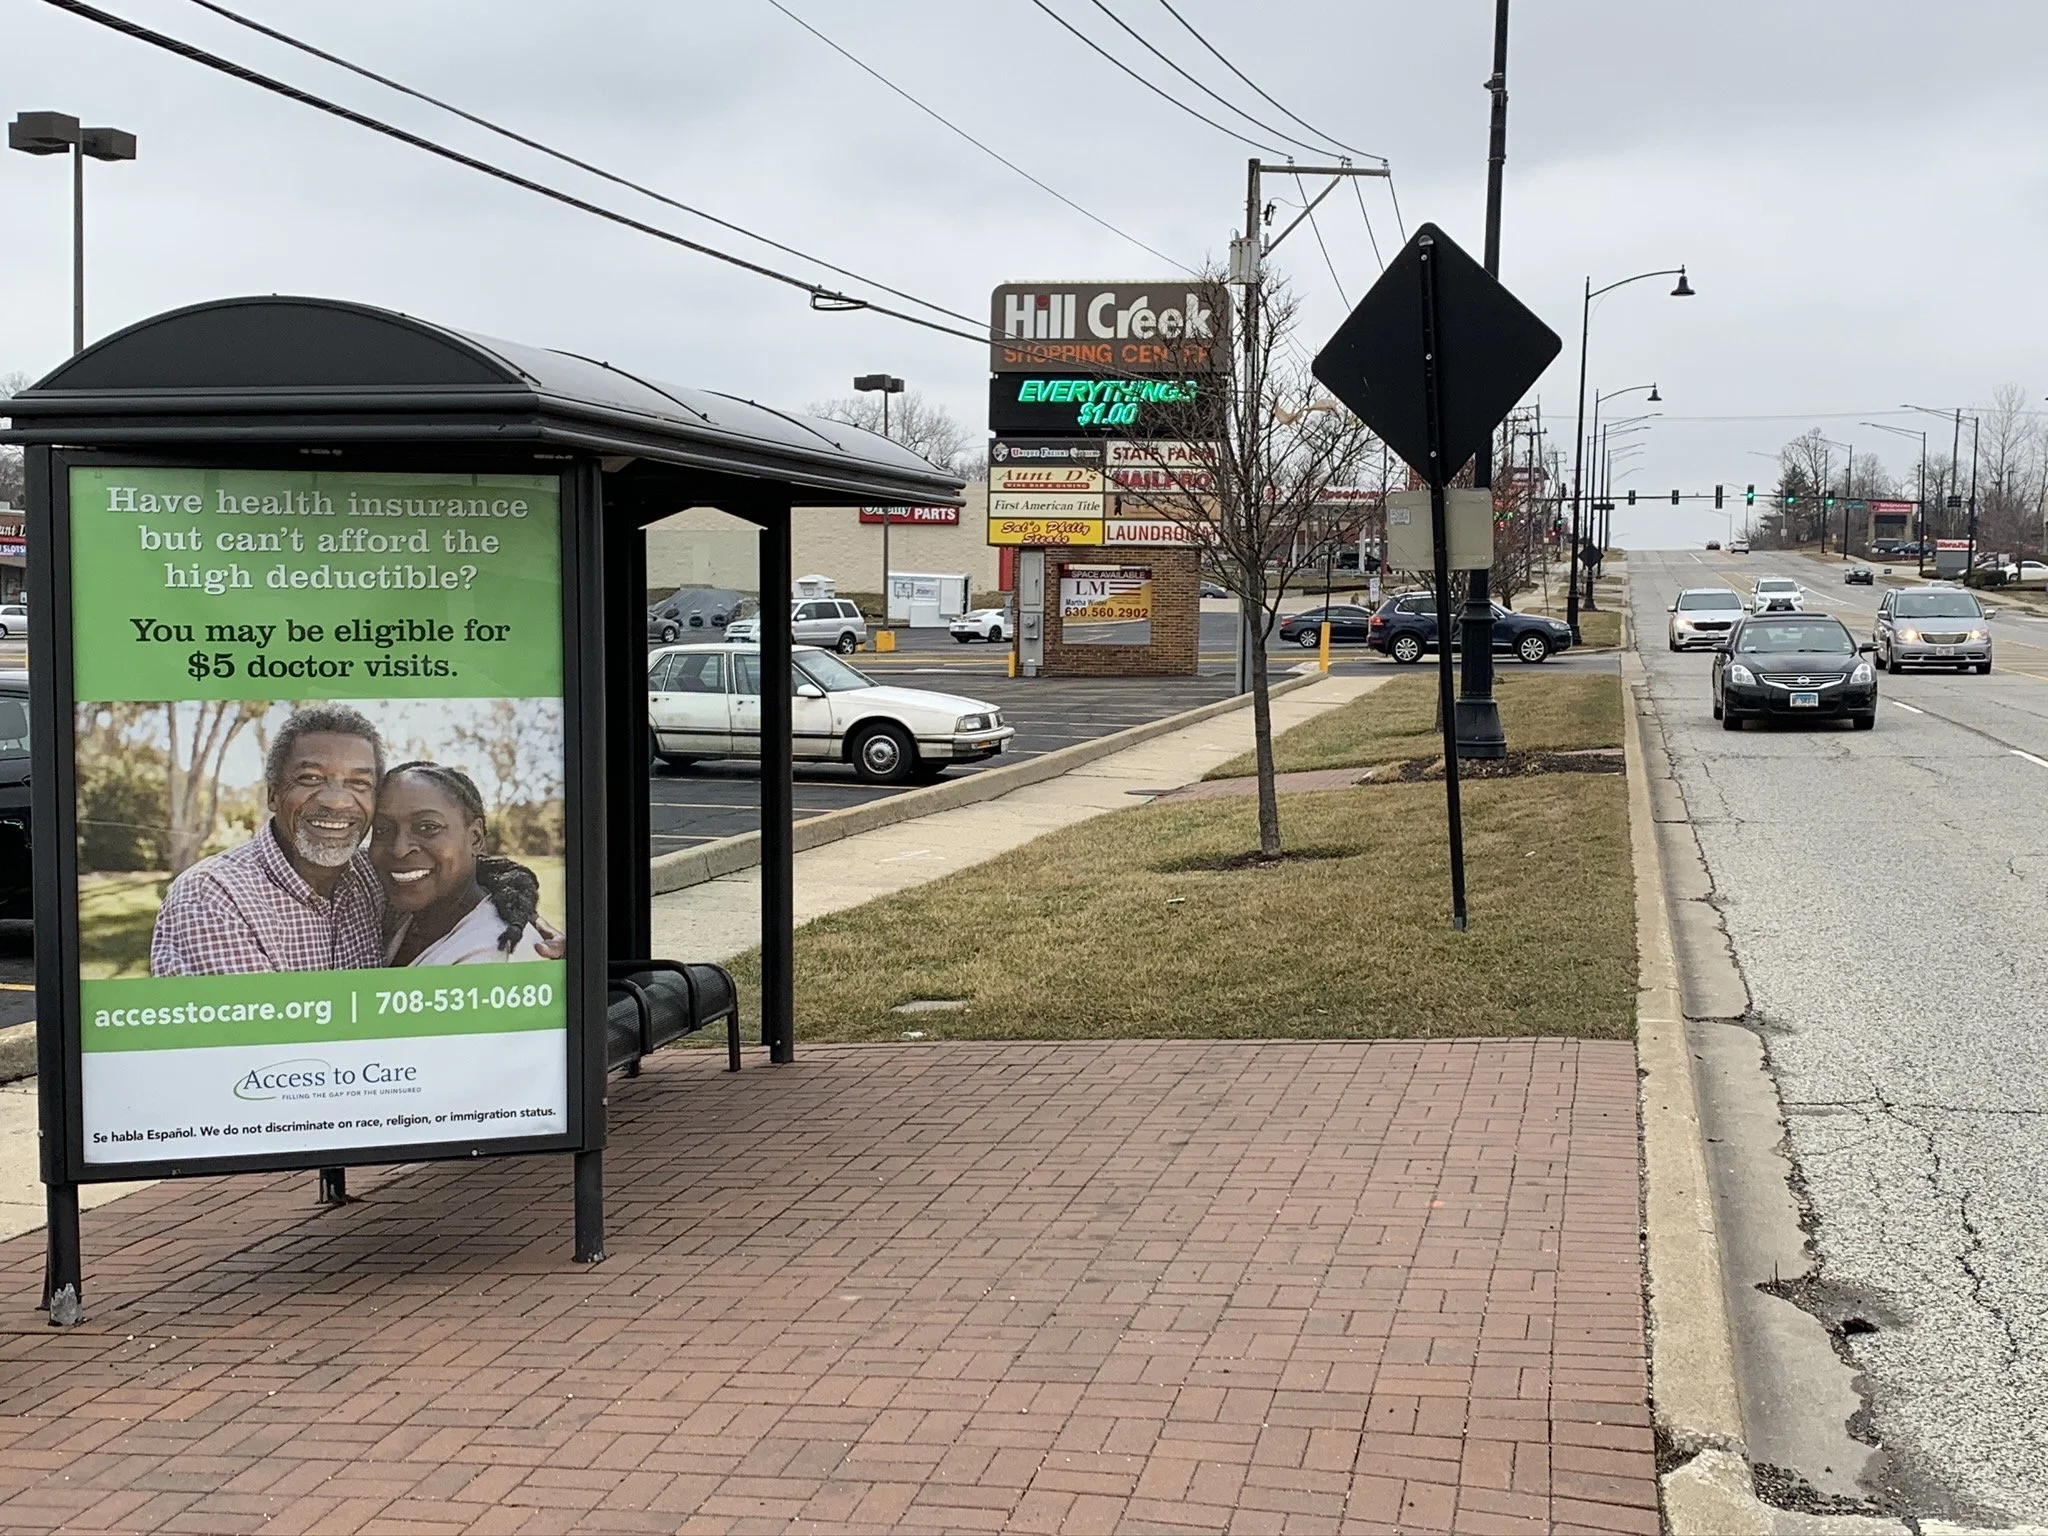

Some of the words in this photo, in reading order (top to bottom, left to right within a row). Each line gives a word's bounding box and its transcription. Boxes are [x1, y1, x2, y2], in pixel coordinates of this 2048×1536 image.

[1004, 294, 1076, 339] Hill
[1087, 292, 1213, 339] Creek
[1003, 344, 1112, 364] SHOPPING
[1122, 344, 1210, 363] CENER
[1077, 402, 1138, 426] $1.00
[1113, 447, 1158, 461] STATE
[997, 469, 1053, 481] Aunt
[106, 487, 203, 514] Have
[216, 489, 336, 516] health
[347, 492, 529, 518] insurance
[994, 500, 1020, 511] First
[1021, 500, 1073, 511] American
[1077, 501, 1100, 511] Title
[914, 508, 956, 520] PARTS
[1001, 522, 1041, 534] Sal's
[1046, 521, 1090, 536] Philly
[1022, 533, 1070, 544] Steaks
[138, 525, 202, 551] but
[216, 527, 305, 553] can't
[317, 528, 430, 554] afford
[442, 529, 500, 554] the
[164, 563, 254, 595] high
[266, 564, 478, 590] deductible?
[1071, 570, 1099, 579] SPACE
[1100, 571, 1145, 579] AVAILABLE
[1076, 581, 1106, 596] LM
[1065, 607, 1149, 618] 630.560.2902
[129, 618, 195, 642] You
[205, 624, 276, 649] may
[286, 619, 324, 642] be
[334, 619, 454, 649] eligible
[464, 618, 511, 642] for
[187, 650, 236, 682] $5
[247, 654, 354, 678] doctor
[364, 654, 458, 677] visits.
[94, 1000, 333, 1028] accesstocare.org
[375, 983, 553, 1014] 708-531-0680
[243, 1069, 325, 1090] Access
[333, 1068, 355, 1085] to
[362, 1063, 417, 1083] Care
[282, 1093, 310, 1101] FILLING
[379, 1086, 422, 1095] UNINSURED
[93, 1132, 108, 1143] Se
[111, 1129, 144, 1143] habla
[148, 1126, 197, 1142] Español.
[199, 1125, 221, 1137] We
[223, 1123, 239, 1135] do
[242, 1121, 262, 1134] not
[265, 1118, 335, 1133] discriminate
[338, 1120, 353, 1130] on
[355, 1118, 383, 1129] race,
[386, 1114, 432, 1129] religion,
[435, 1113, 447, 1123] or
[450, 1109, 517, 1123] immigration
[519, 1107, 556, 1118] status.
